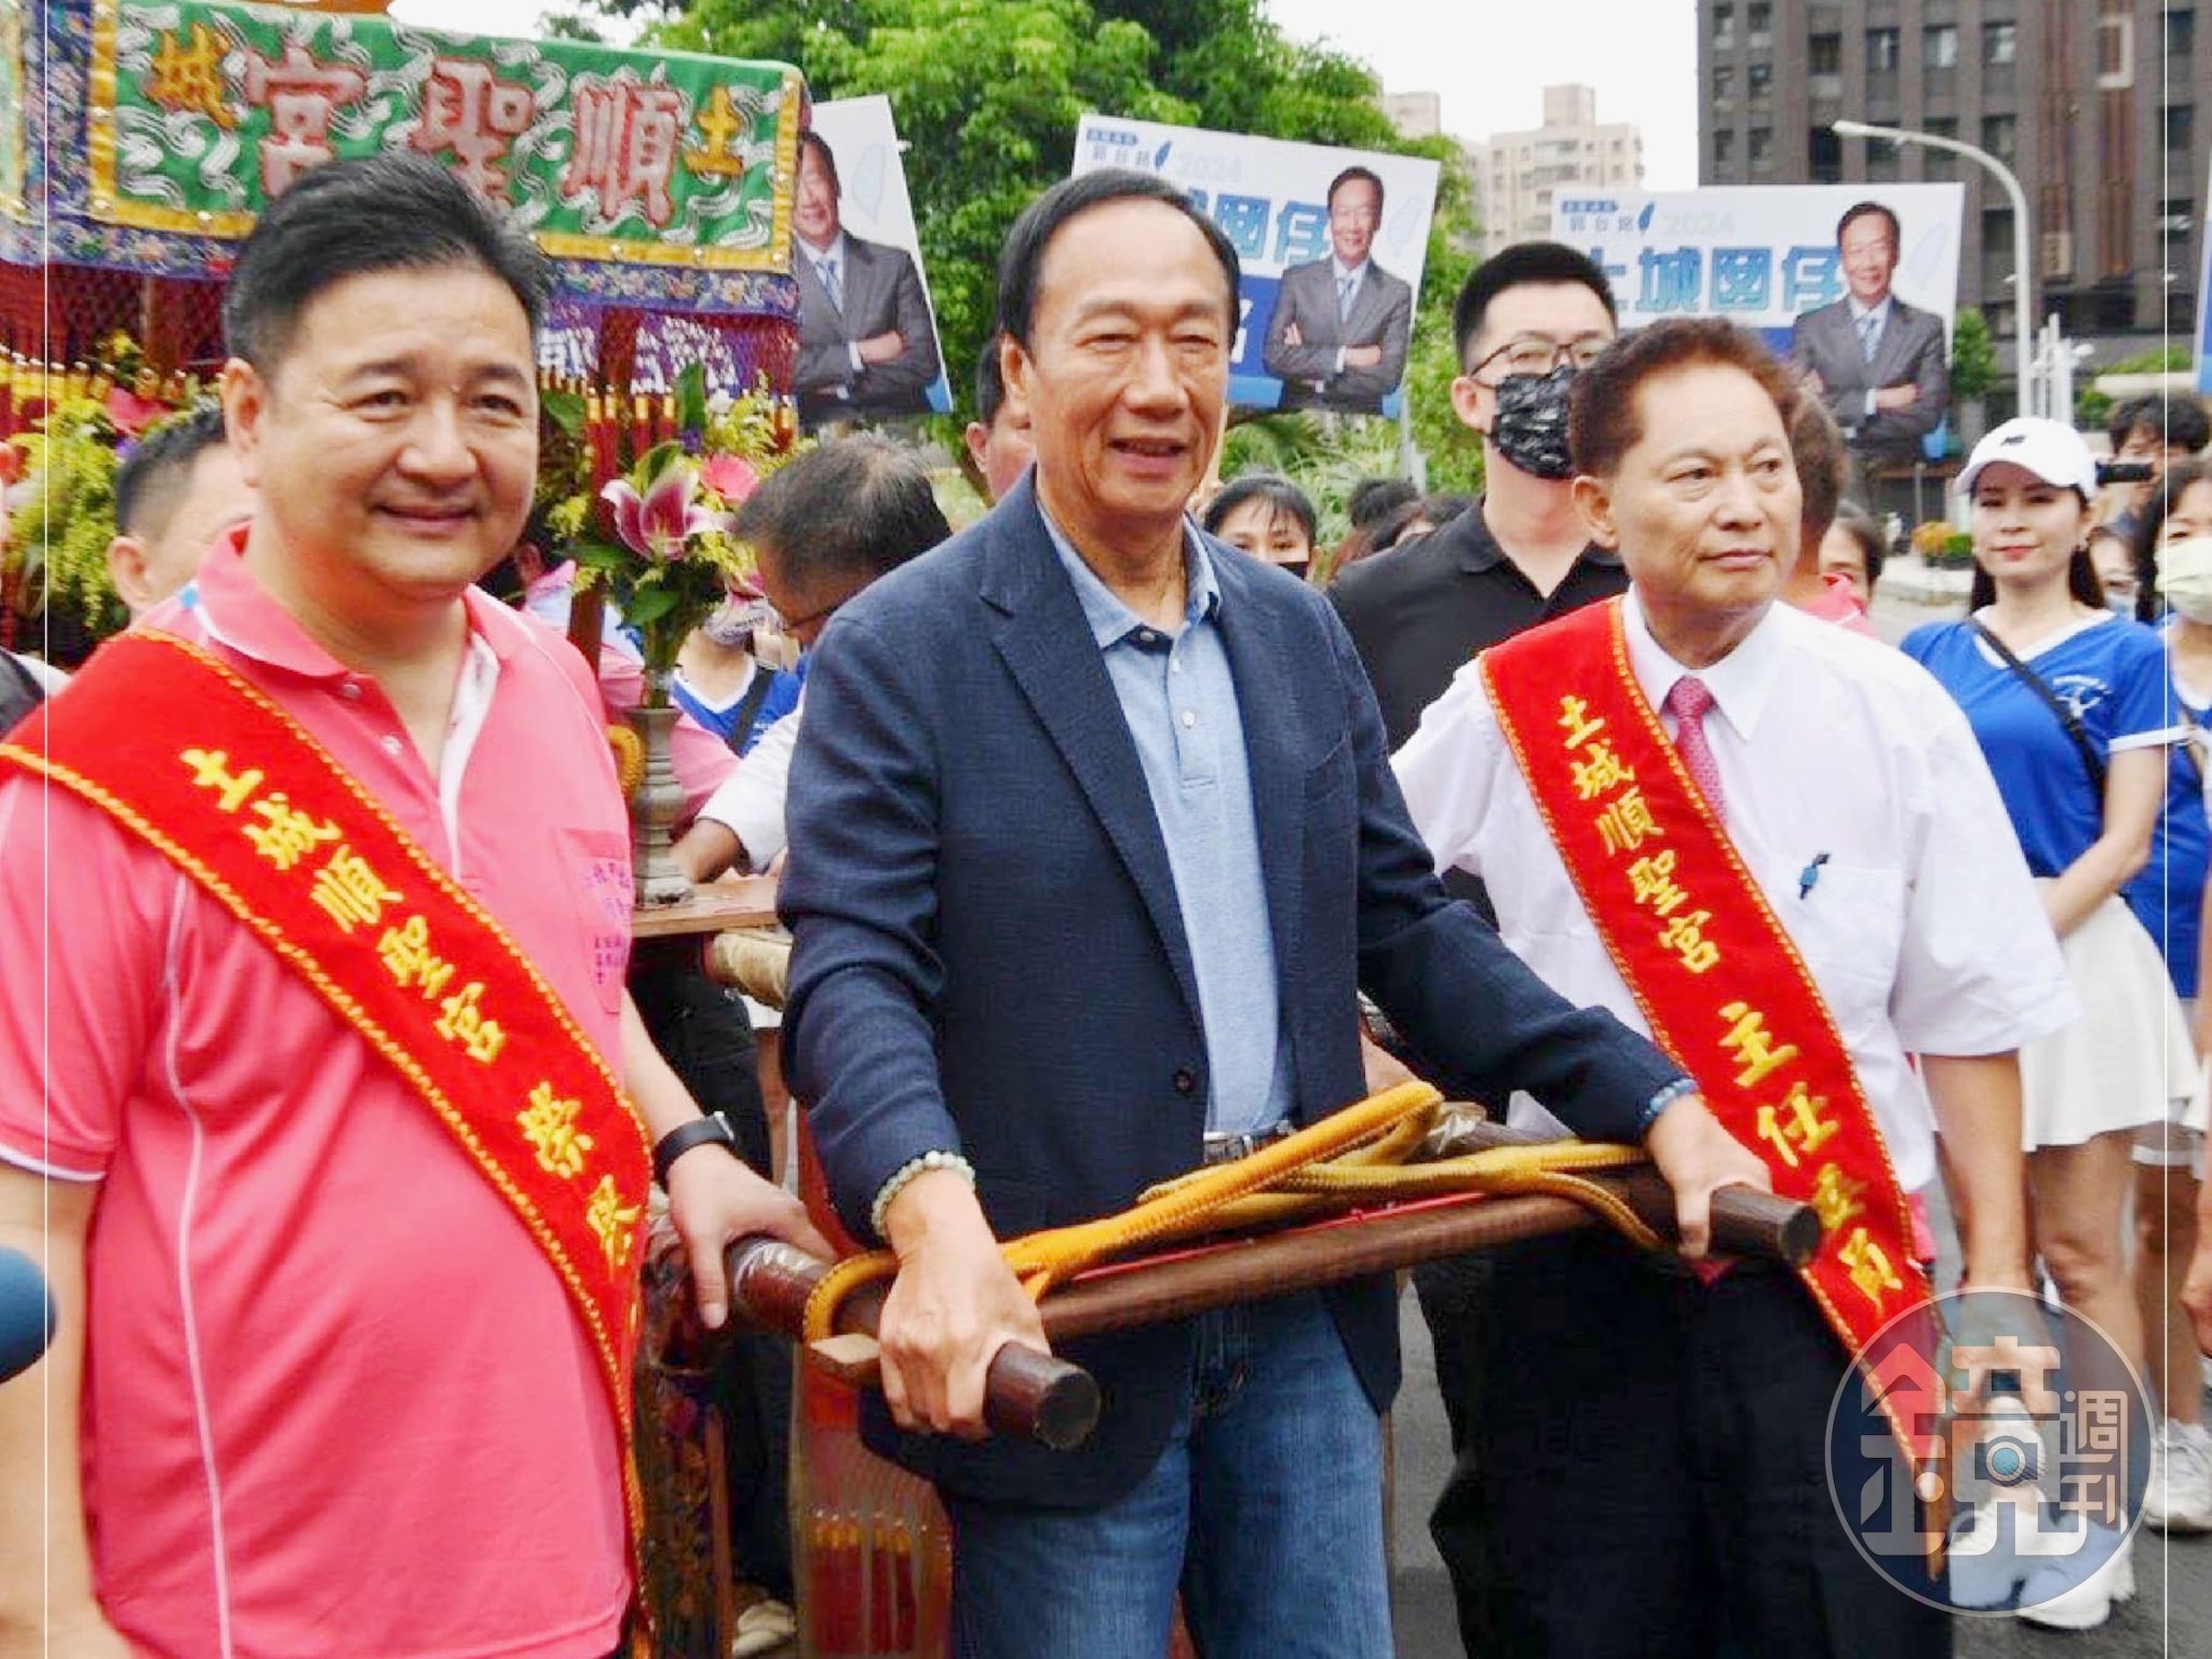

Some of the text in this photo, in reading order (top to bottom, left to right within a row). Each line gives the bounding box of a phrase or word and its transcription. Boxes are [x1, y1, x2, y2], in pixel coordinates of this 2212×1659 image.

[684, 88, 744, 176] 土
[181, 747, 507, 1064] 土城順聖宮
[1557, 696, 1721, 974] 土城順聖宮
